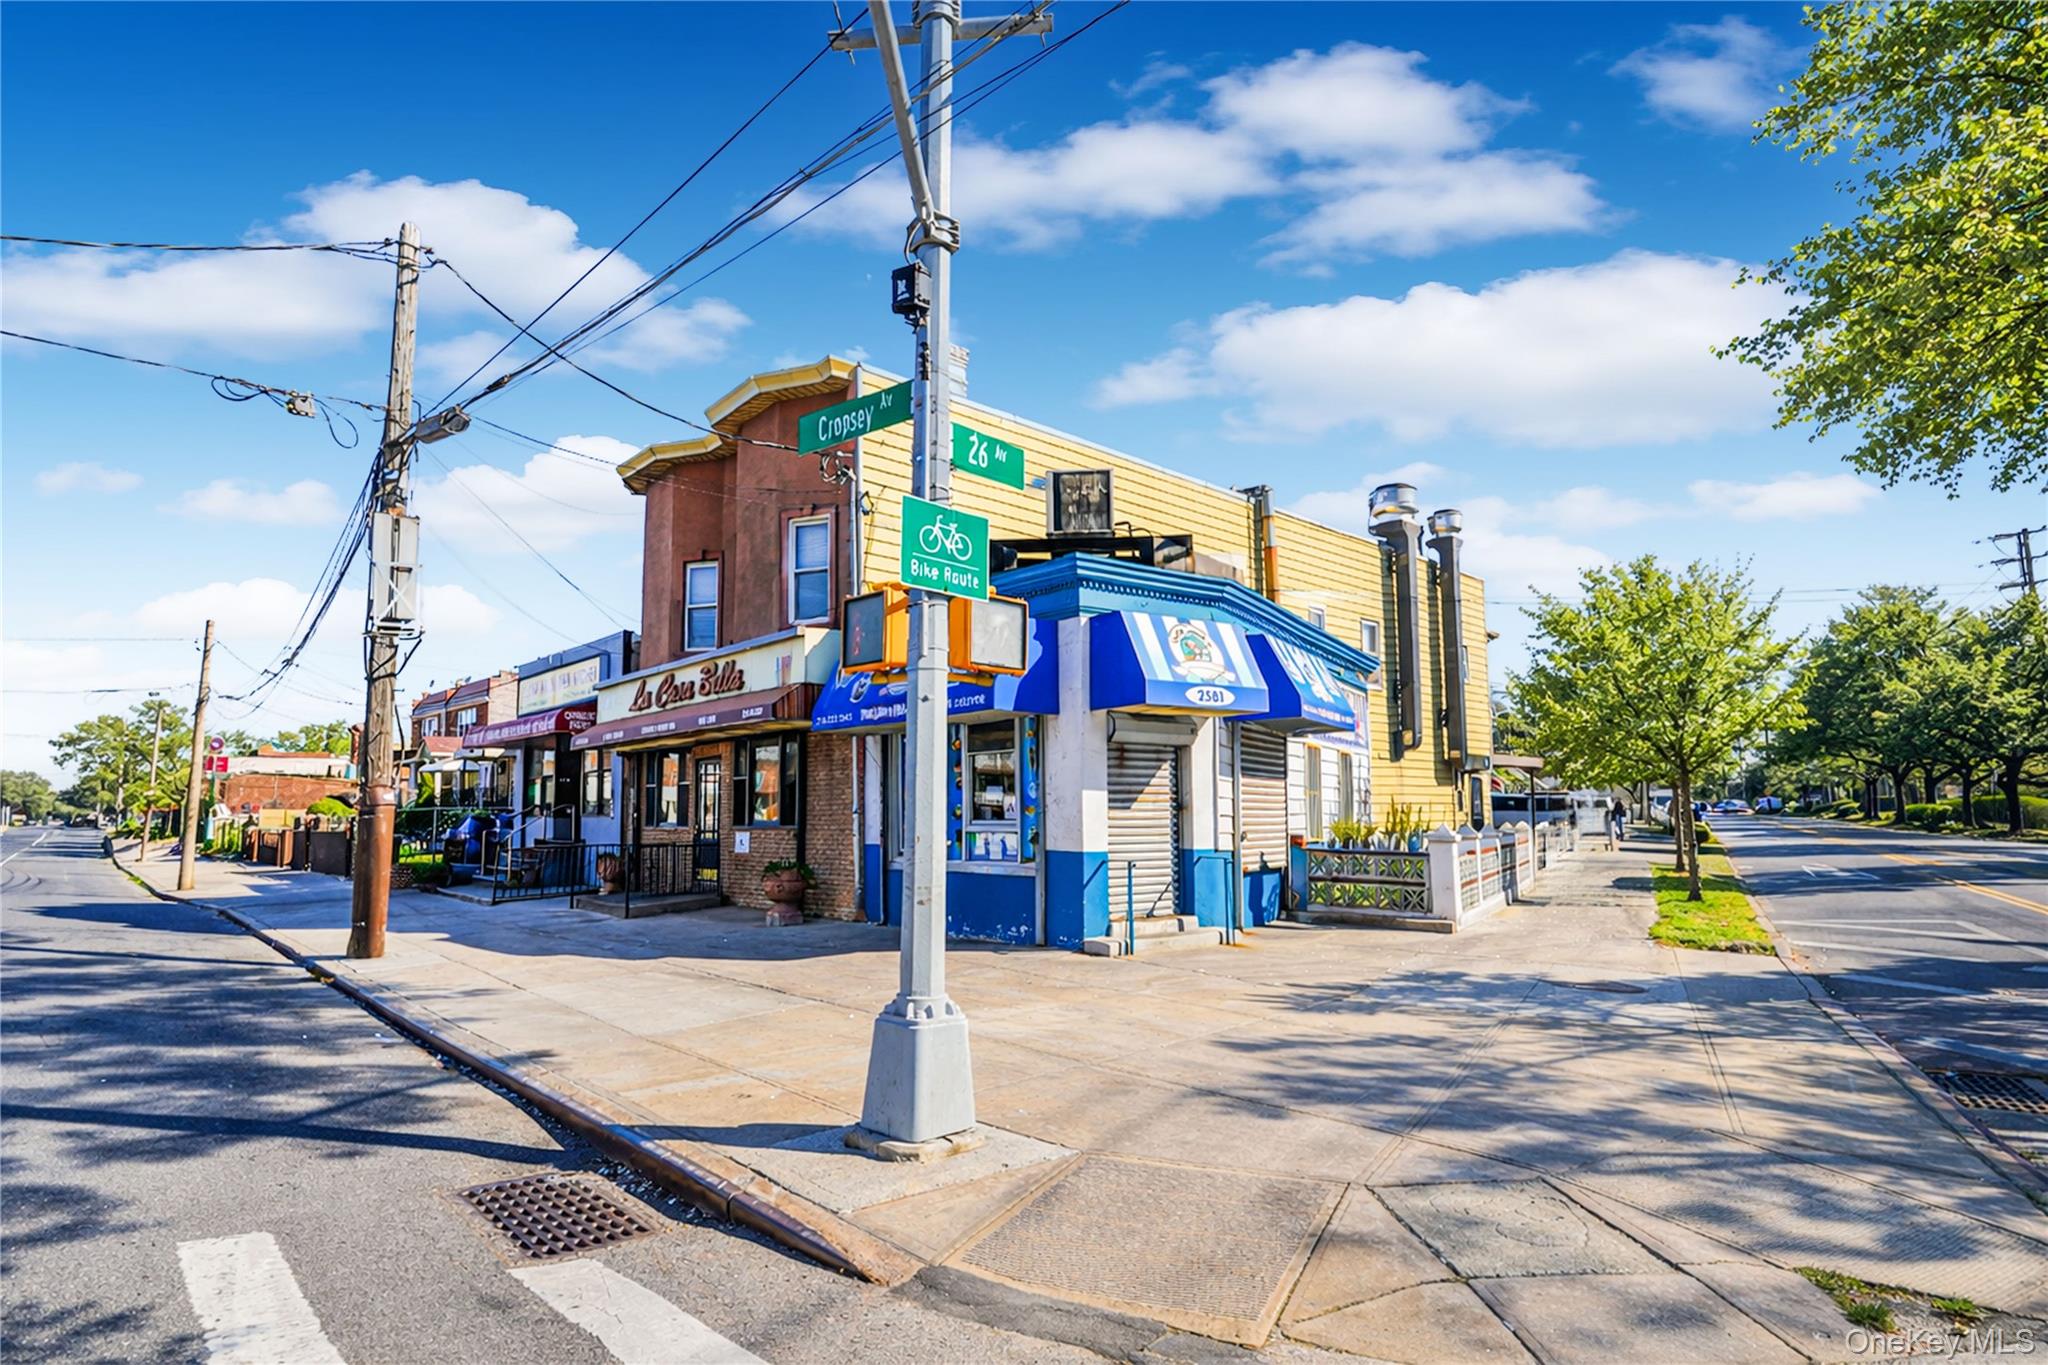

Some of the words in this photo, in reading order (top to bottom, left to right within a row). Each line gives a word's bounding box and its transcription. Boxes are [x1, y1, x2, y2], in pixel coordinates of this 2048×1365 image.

[818, 404, 874, 441] Cropsey
[880, 392, 893, 409] Av
[968, 432, 988, 468] 26
[995, 444, 1007, 463] Av
[911, 558, 939, 581] Bike
[944, 567, 979, 589] Route
[629, 679, 653, 712] La
[655, 672, 696, 708] Casa
